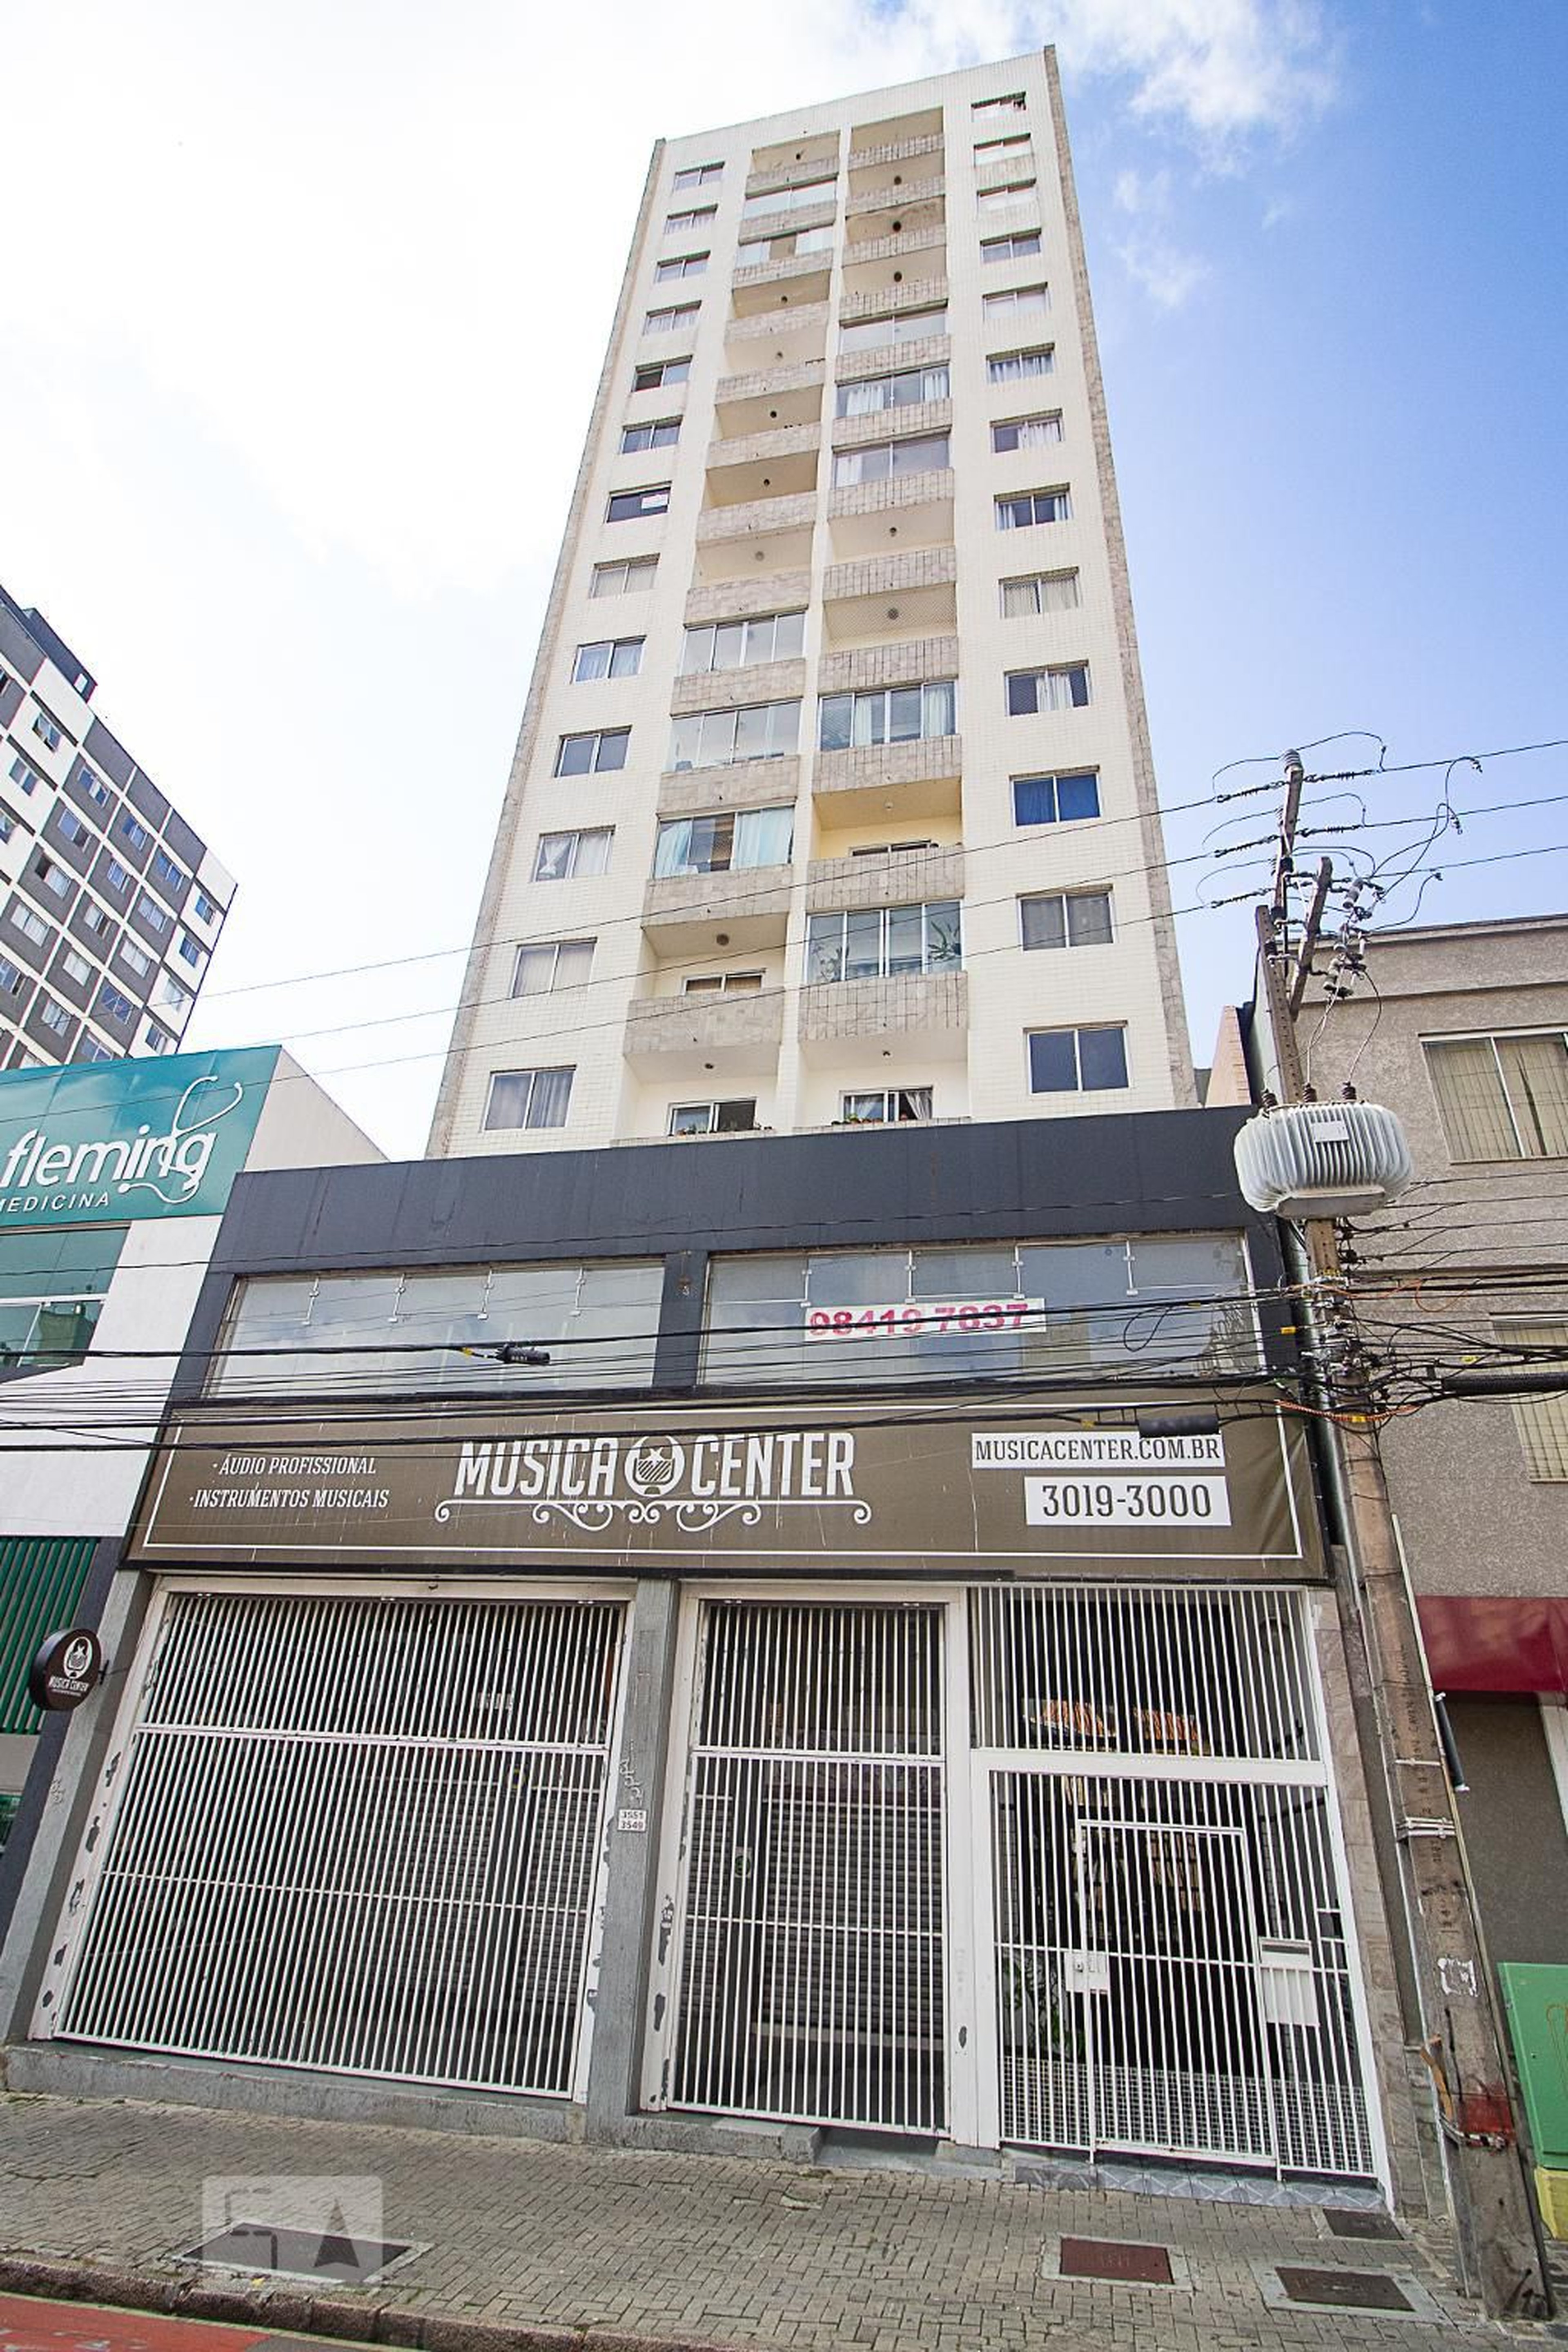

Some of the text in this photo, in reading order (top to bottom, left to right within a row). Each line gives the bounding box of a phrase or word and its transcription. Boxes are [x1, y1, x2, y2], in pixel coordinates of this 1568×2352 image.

[0, 1125, 217, 1192] fleming
[975, 1438, 1221, 1461] MUSICACENTER.COM.BR
[218, 1453, 376, 1475] ÁUDIO PROFISSIONAL
[454, 1432, 856, 1496] MUSICA CENTER
[193, 1489, 390, 1508] INSTRUMENTOS MUSICAIS
[1042, 1484, 1212, 1517] 3019-3000
